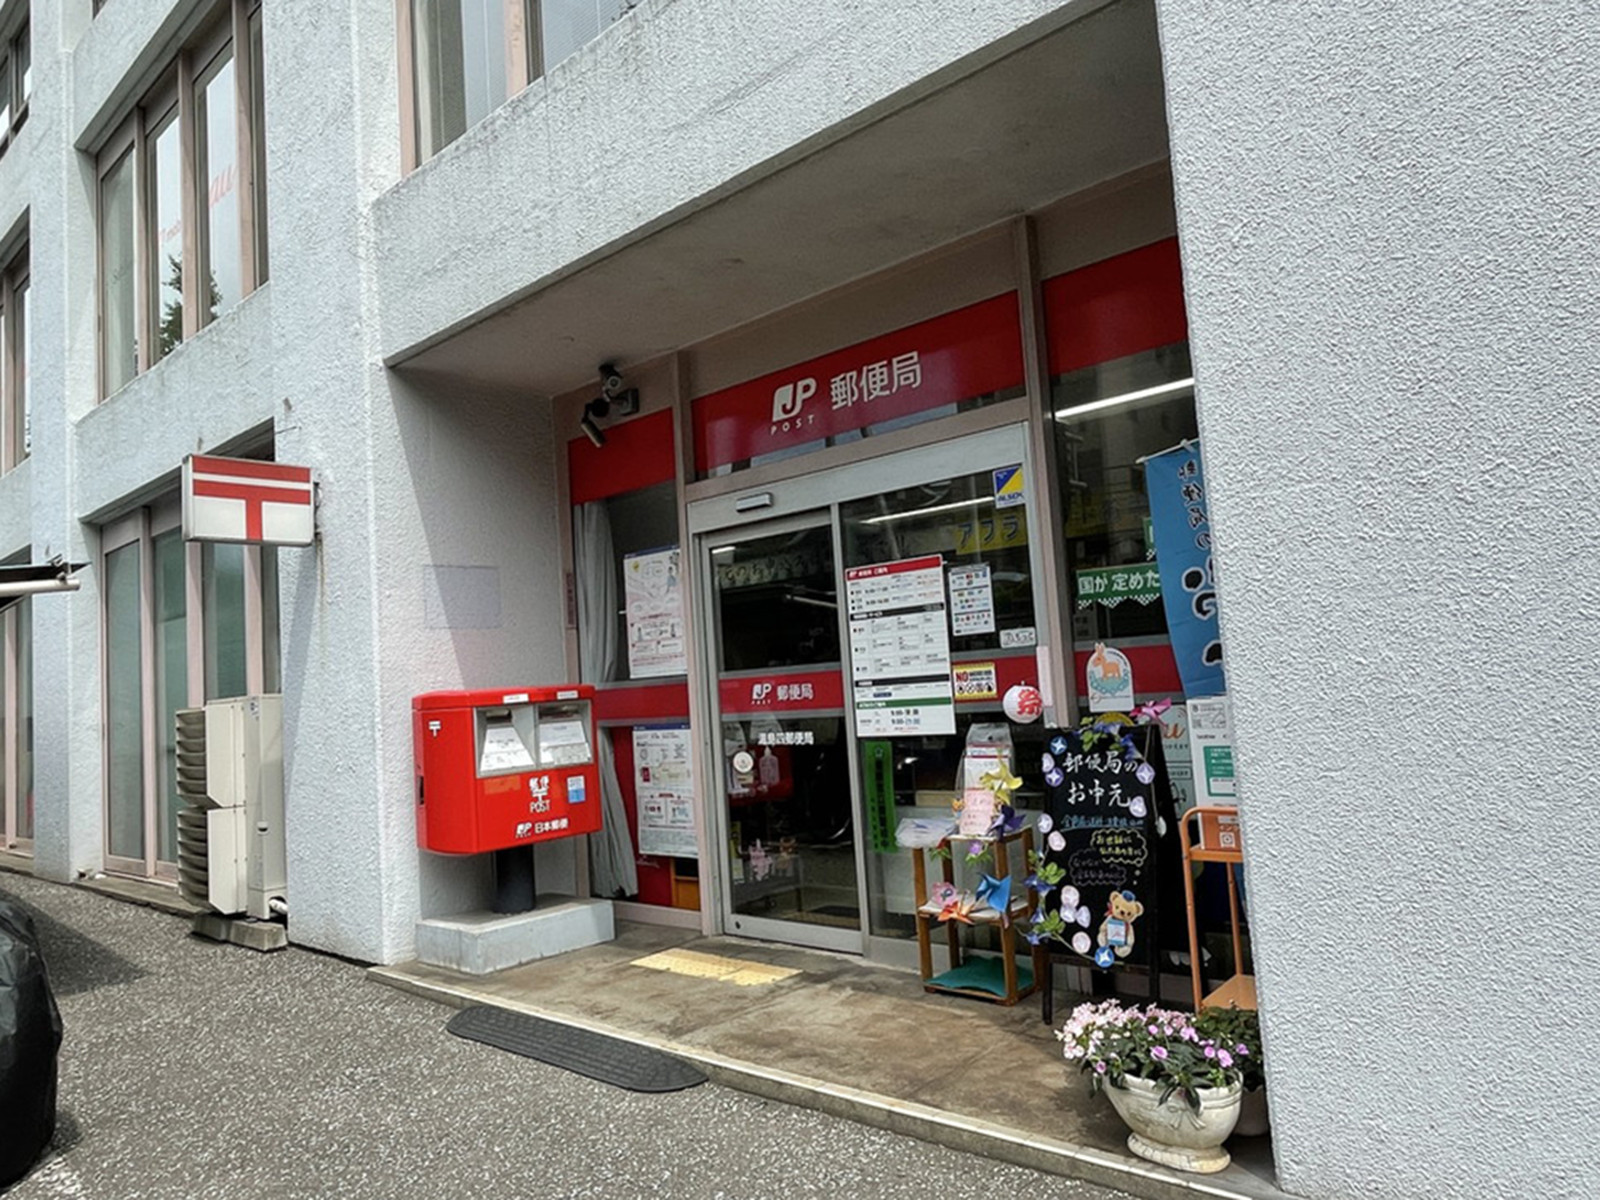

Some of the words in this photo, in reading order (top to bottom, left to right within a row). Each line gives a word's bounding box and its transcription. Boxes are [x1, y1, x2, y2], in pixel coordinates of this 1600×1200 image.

[830, 350, 921, 410] 郵便局
[771, 414, 815, 435] POST
[777, 683, 814, 701] 郵便局
[1062, 751, 1138, 774] 郵便局の
[1067, 779, 1131, 806] お中元
[530, 800, 551, 813] POST
